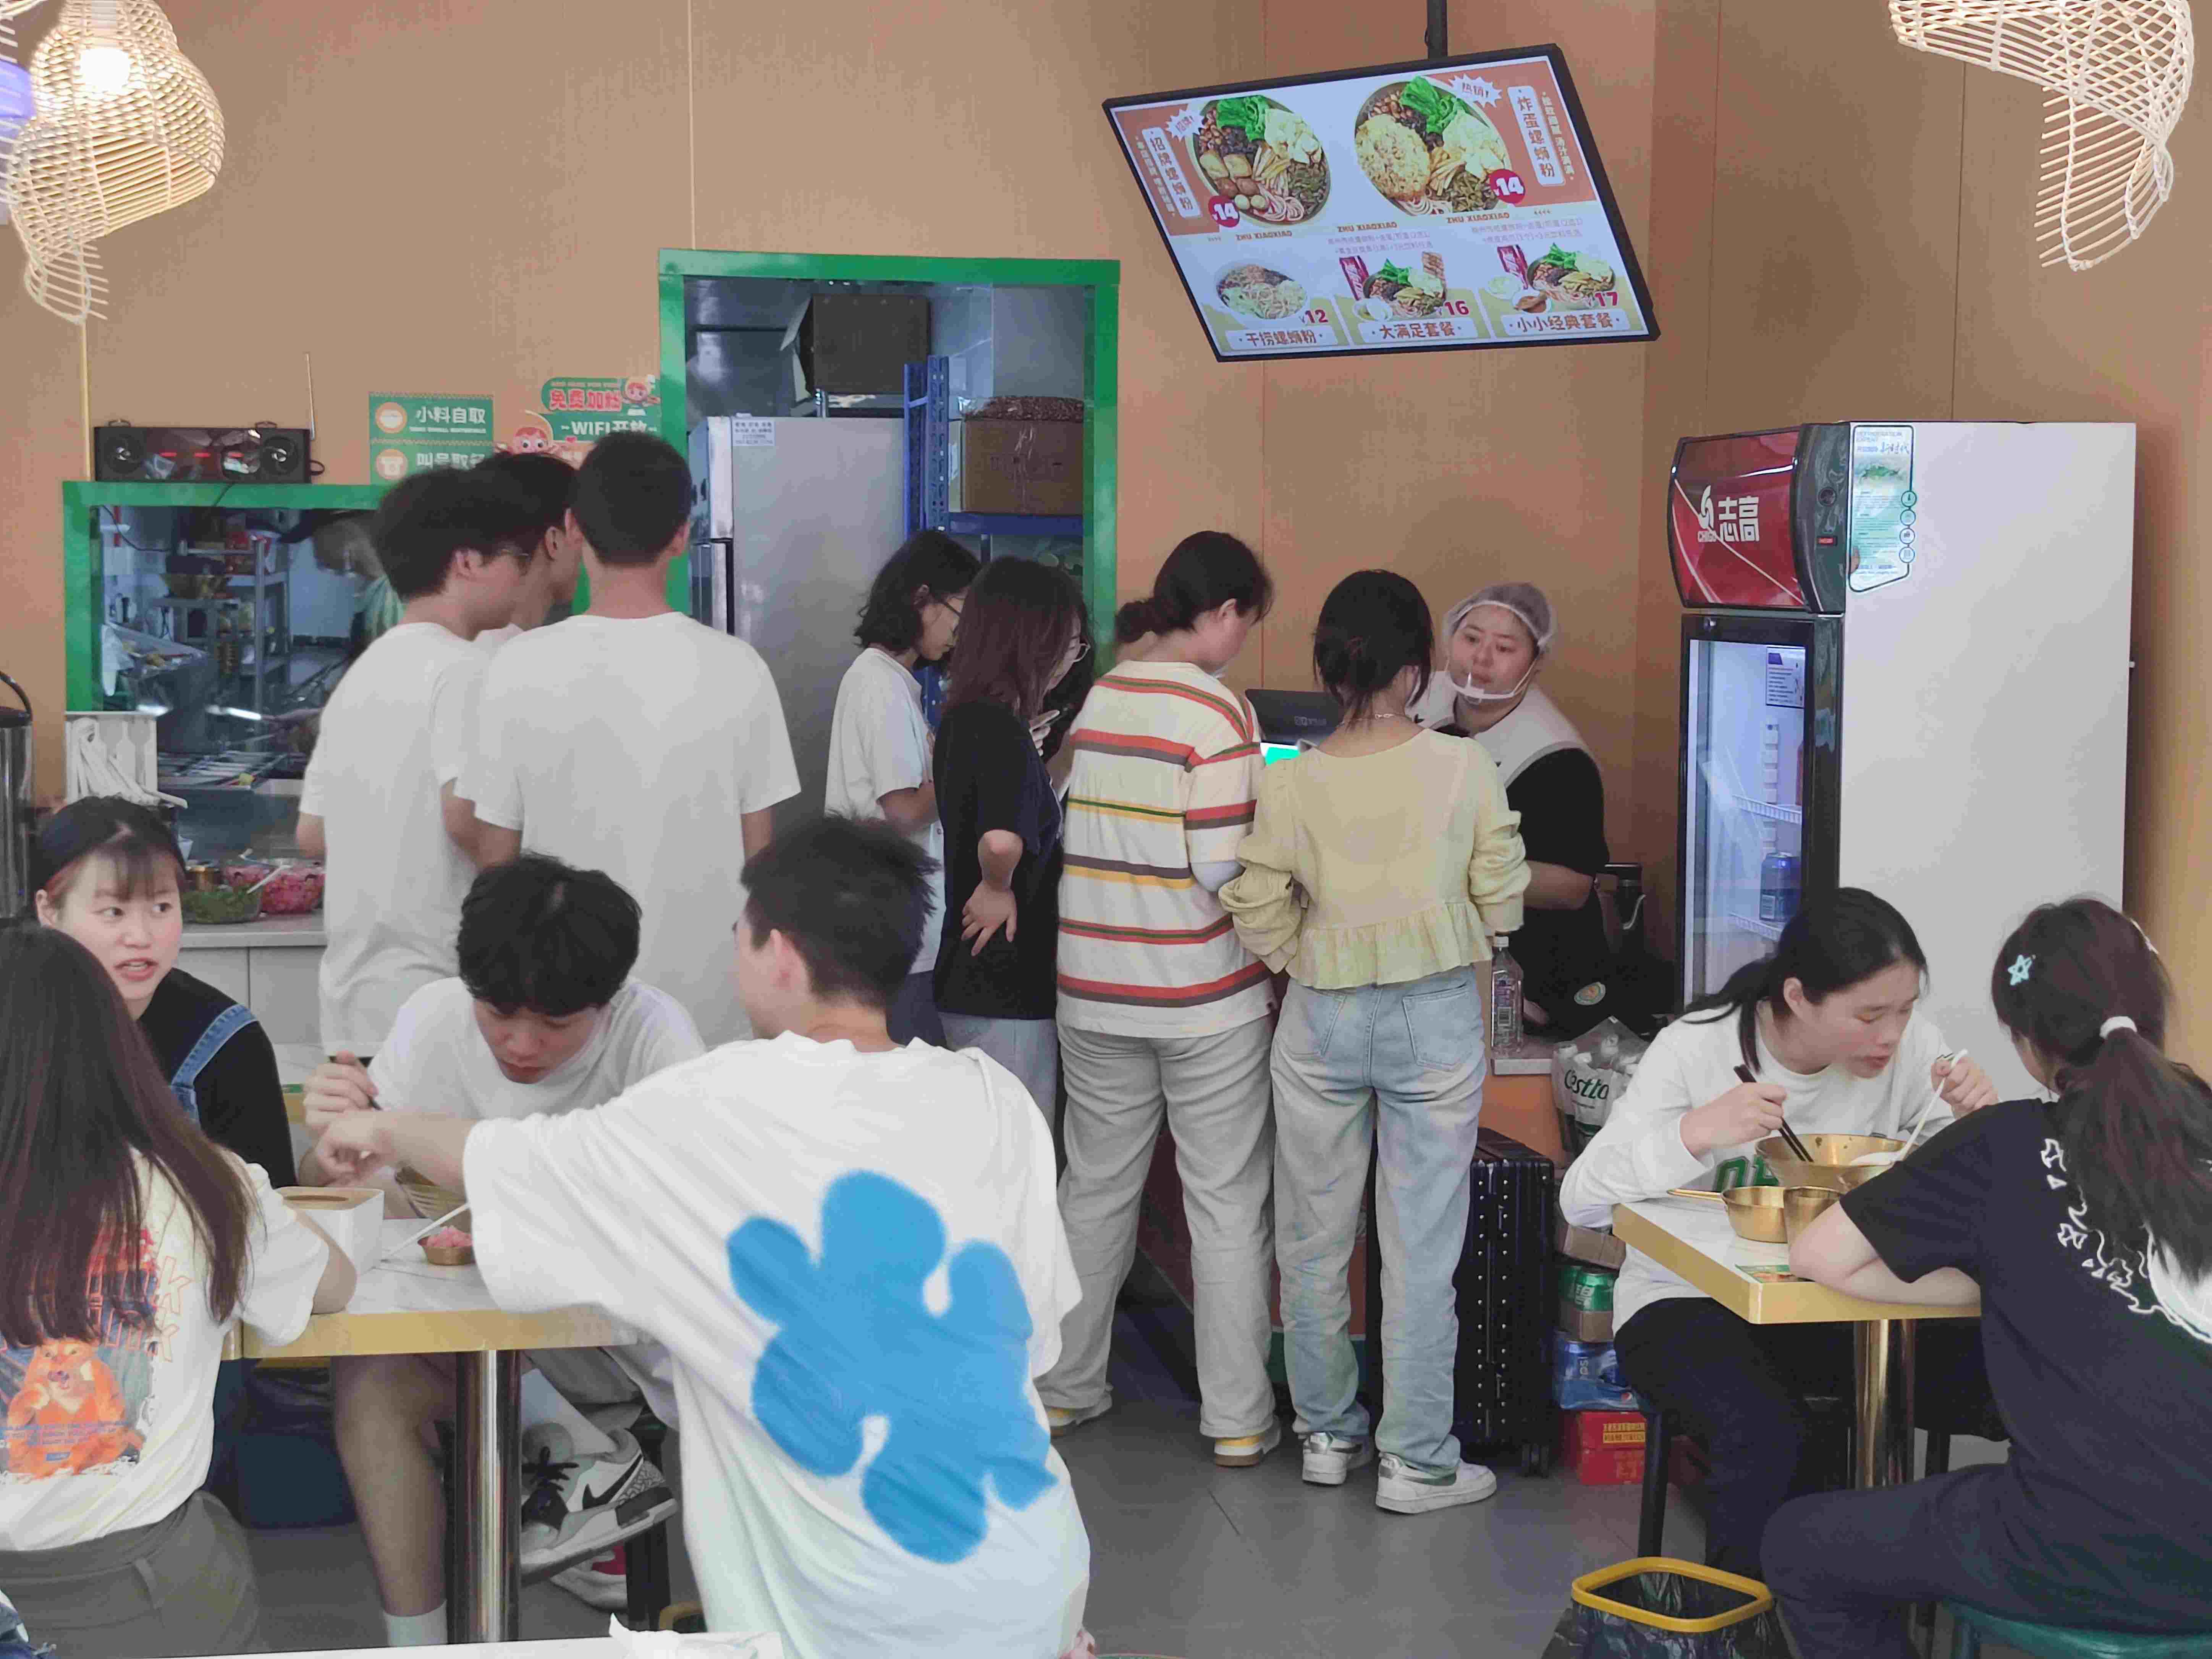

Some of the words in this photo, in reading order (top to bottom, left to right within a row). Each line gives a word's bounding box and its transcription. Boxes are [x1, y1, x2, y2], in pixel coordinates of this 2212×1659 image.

[1379, 322, 1455, 340] 大满足套餐
[1517, 312, 1614, 332] 小小经典套餐
[1245, 330, 1317, 348] 干捞螺蛳粉
[416, 406, 486, 424] 小料自取
[1718, 496, 1759, 542] 志高
